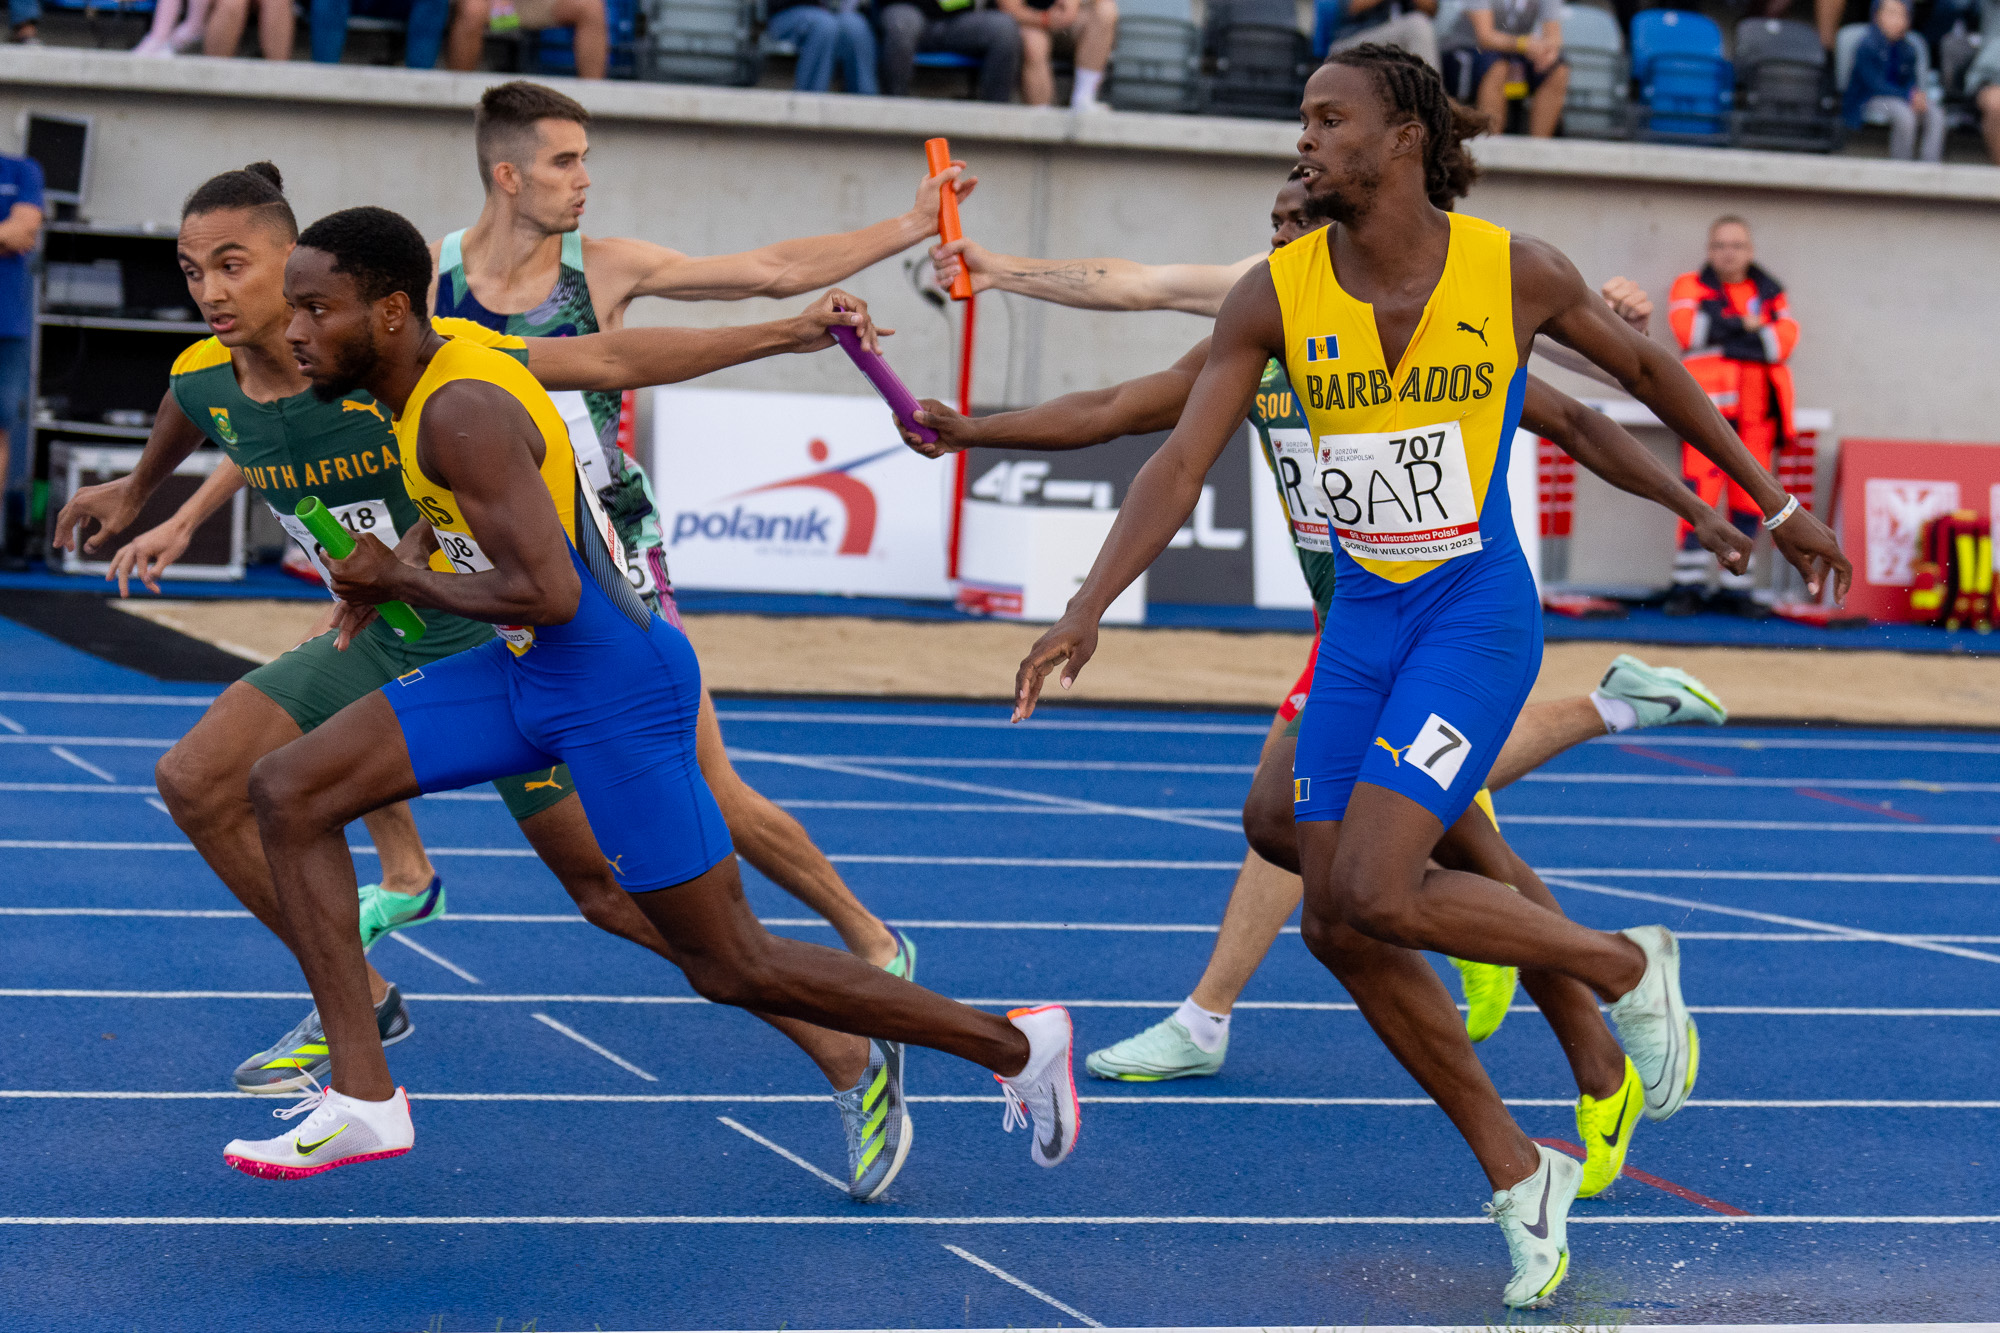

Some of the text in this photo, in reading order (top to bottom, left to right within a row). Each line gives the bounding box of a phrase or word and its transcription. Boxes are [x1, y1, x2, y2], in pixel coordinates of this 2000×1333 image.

[1256, 392, 1301, 419] SOU
[1306, 362, 1494, 410] BARBADOS
[236, 445, 399, 490] OUTH AFRICA
[1389, 431, 1446, 464] 707
[1321, 460, 1448, 525] BAR
[671, 486, 830, 547] polanik
[1360, 534, 1379, 543] PZLA
[1379, 532, 1431, 543] Mistrzostwa
[1432, 527, 1459, 539] Polski
[1380, 543, 1448, 555] WIELKOPOLSKI
[1449, 537, 1474, 550] 2023
[1423, 724, 1463, 770] 7
